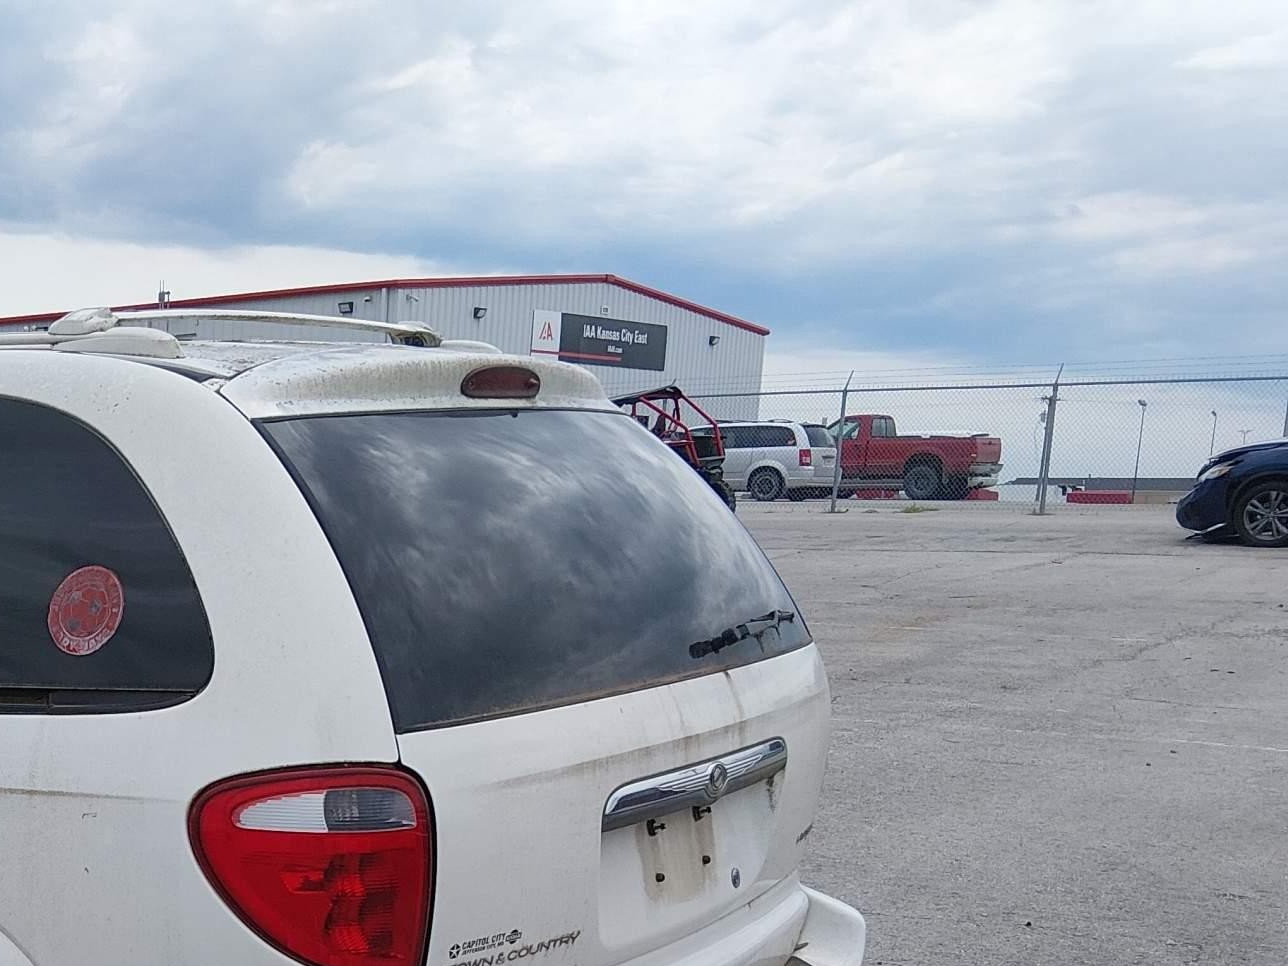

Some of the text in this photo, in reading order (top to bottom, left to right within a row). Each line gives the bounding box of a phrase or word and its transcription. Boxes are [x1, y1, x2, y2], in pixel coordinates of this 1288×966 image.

[583, 324, 648, 345] IAA Kansas City East
[462, 932, 506, 950] CAPITOL CITY
